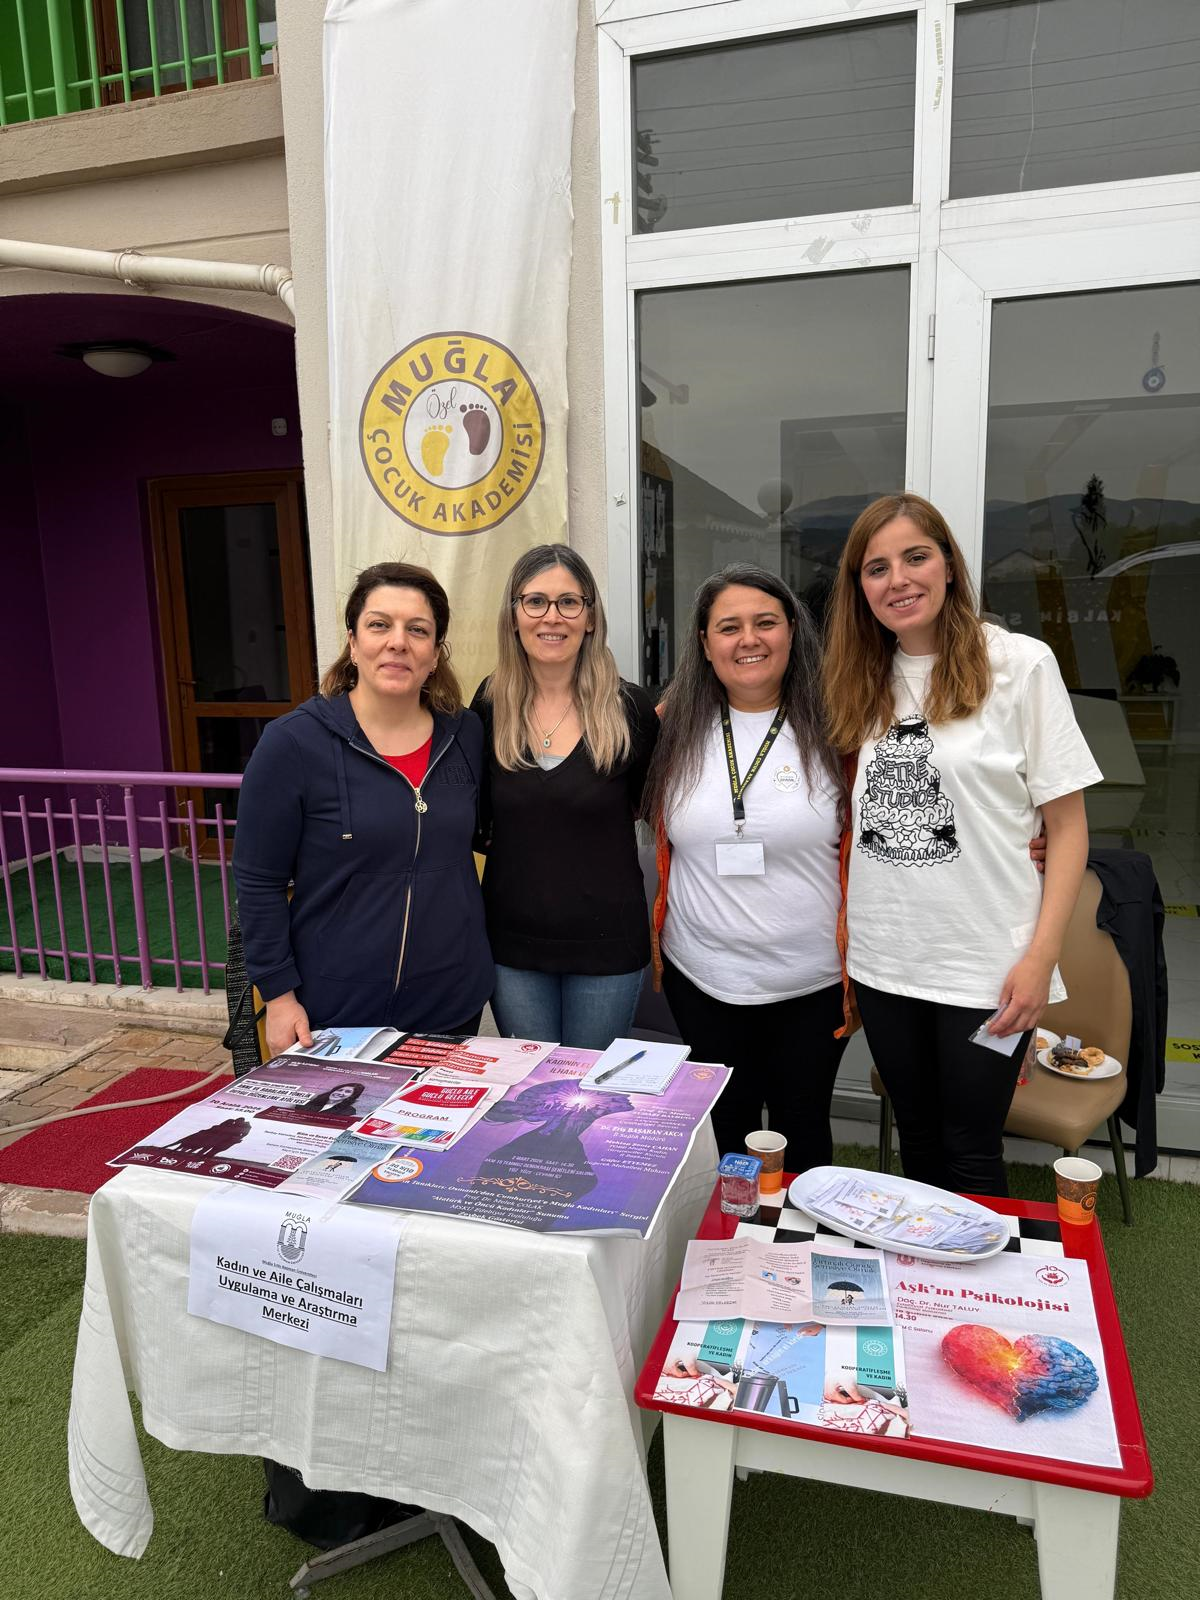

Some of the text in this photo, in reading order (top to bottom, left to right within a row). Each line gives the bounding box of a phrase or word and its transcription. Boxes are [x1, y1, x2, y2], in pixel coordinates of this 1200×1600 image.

[381, 340, 518, 416] MUĞLA
[426, 386, 457, 419] Özel
[367, 422, 533, 522] ÇOCUK AKADEMİSİ
[874, 756, 929, 782] SETRE
[870, 786, 937, 808] STUDIOS
[398, 1109, 450, 1121] PROGRAM
[285, 1211, 311, 1223] MUĞLA
[216, 1256, 362, 1307] Kadın ve Aile Çalışmaları
[219, 1275, 357, 1324] Uygulama ve Araştırma
[896, 1281, 1071, 1312] Aşk'ın Psikolojisi
[262, 1306, 310, 1329] Merkezi
[895, 1313, 917, 1321] 14.30
